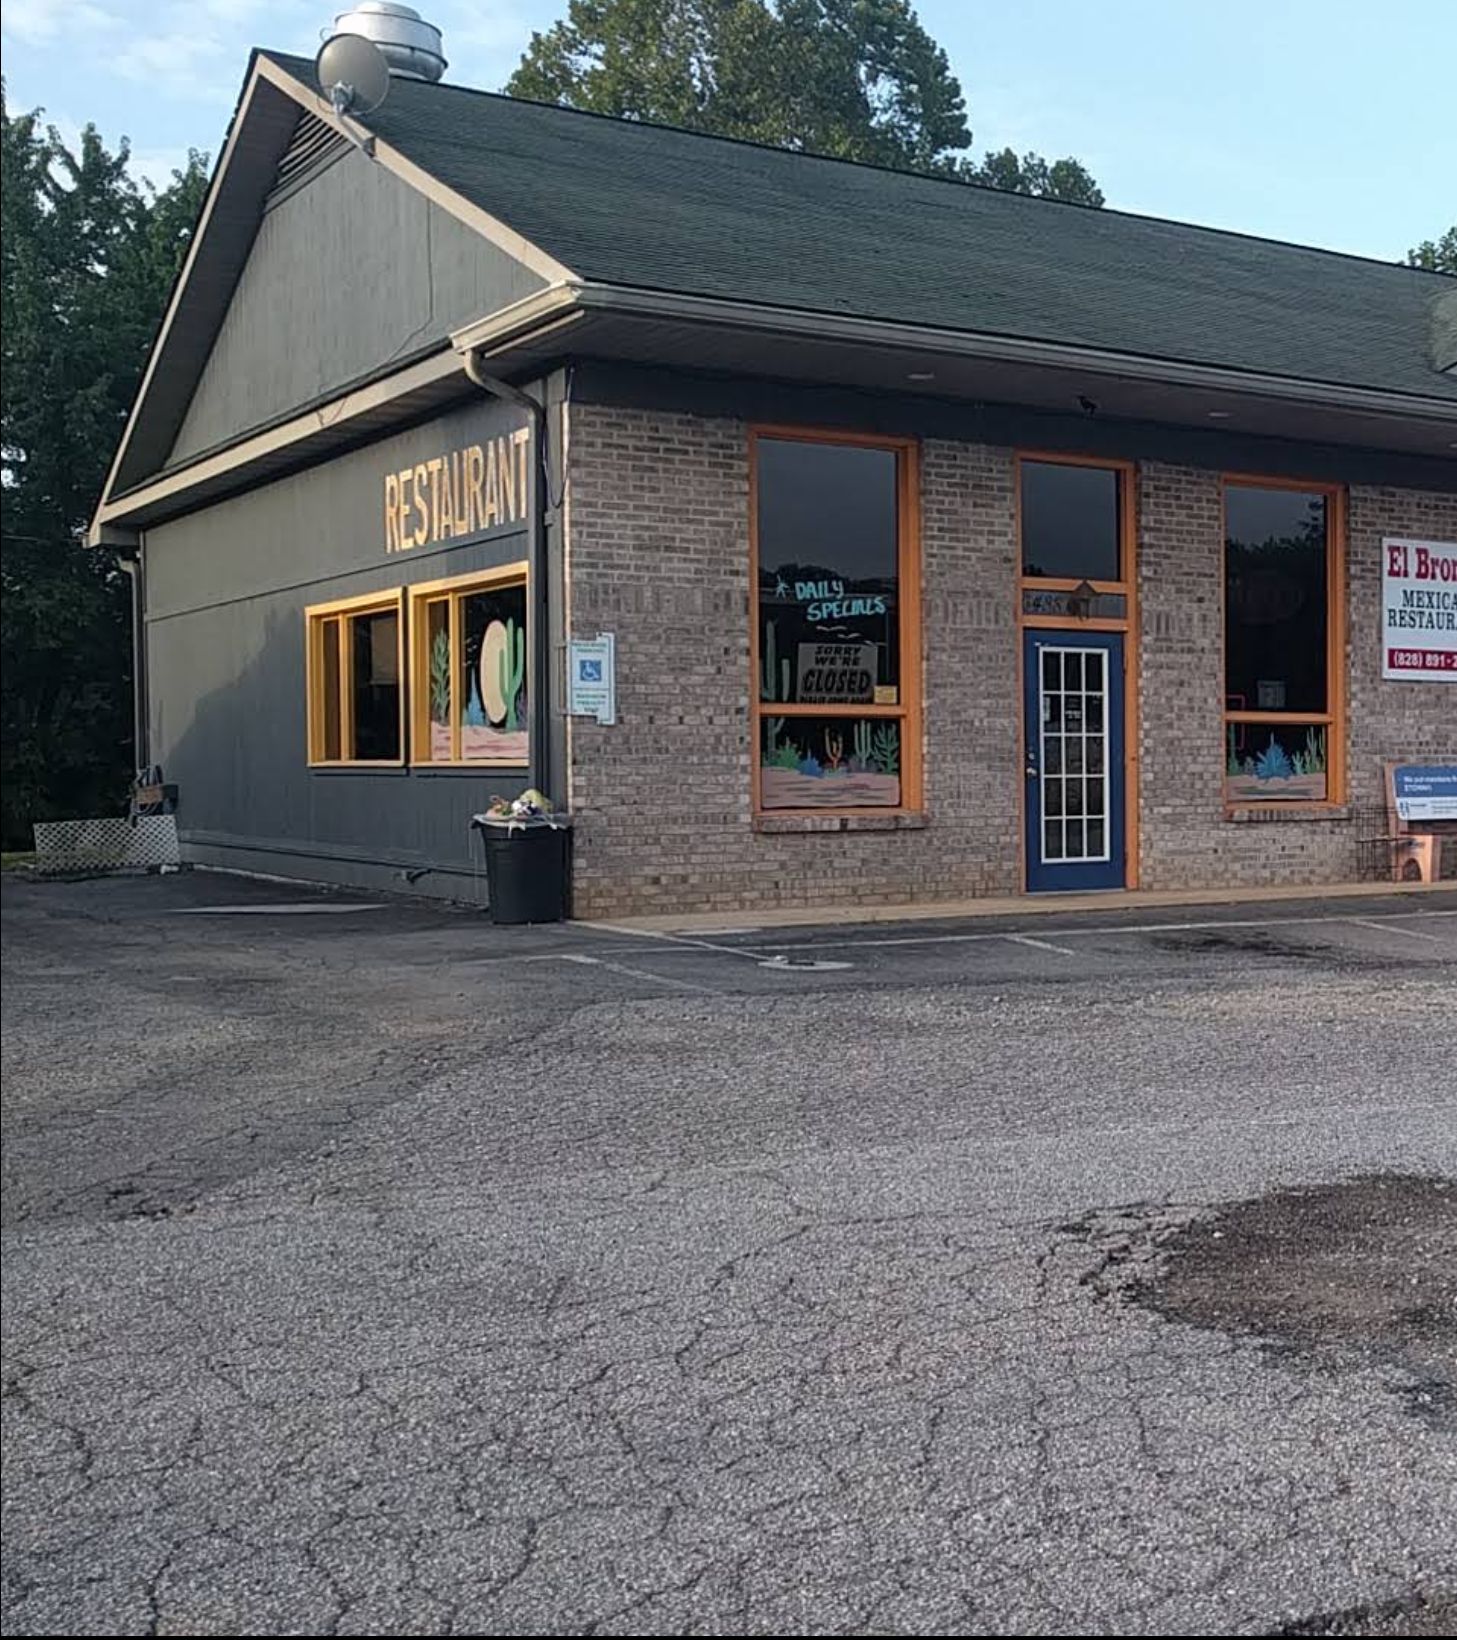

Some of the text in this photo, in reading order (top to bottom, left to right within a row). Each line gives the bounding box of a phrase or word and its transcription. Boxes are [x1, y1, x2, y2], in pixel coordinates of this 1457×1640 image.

[385, 426, 530, 554] RESTAURANT
[1387, 545, 1409, 578] El
[795, 581, 844, 600] DAILY
[806, 597, 886, 621] SPECIALS
[815, 645, 861, 656] SORRY
[1394, 651, 1423, 667] (828)
[815, 656, 861, 667] WE'RE
[802, 669, 872, 694] CLOSED
